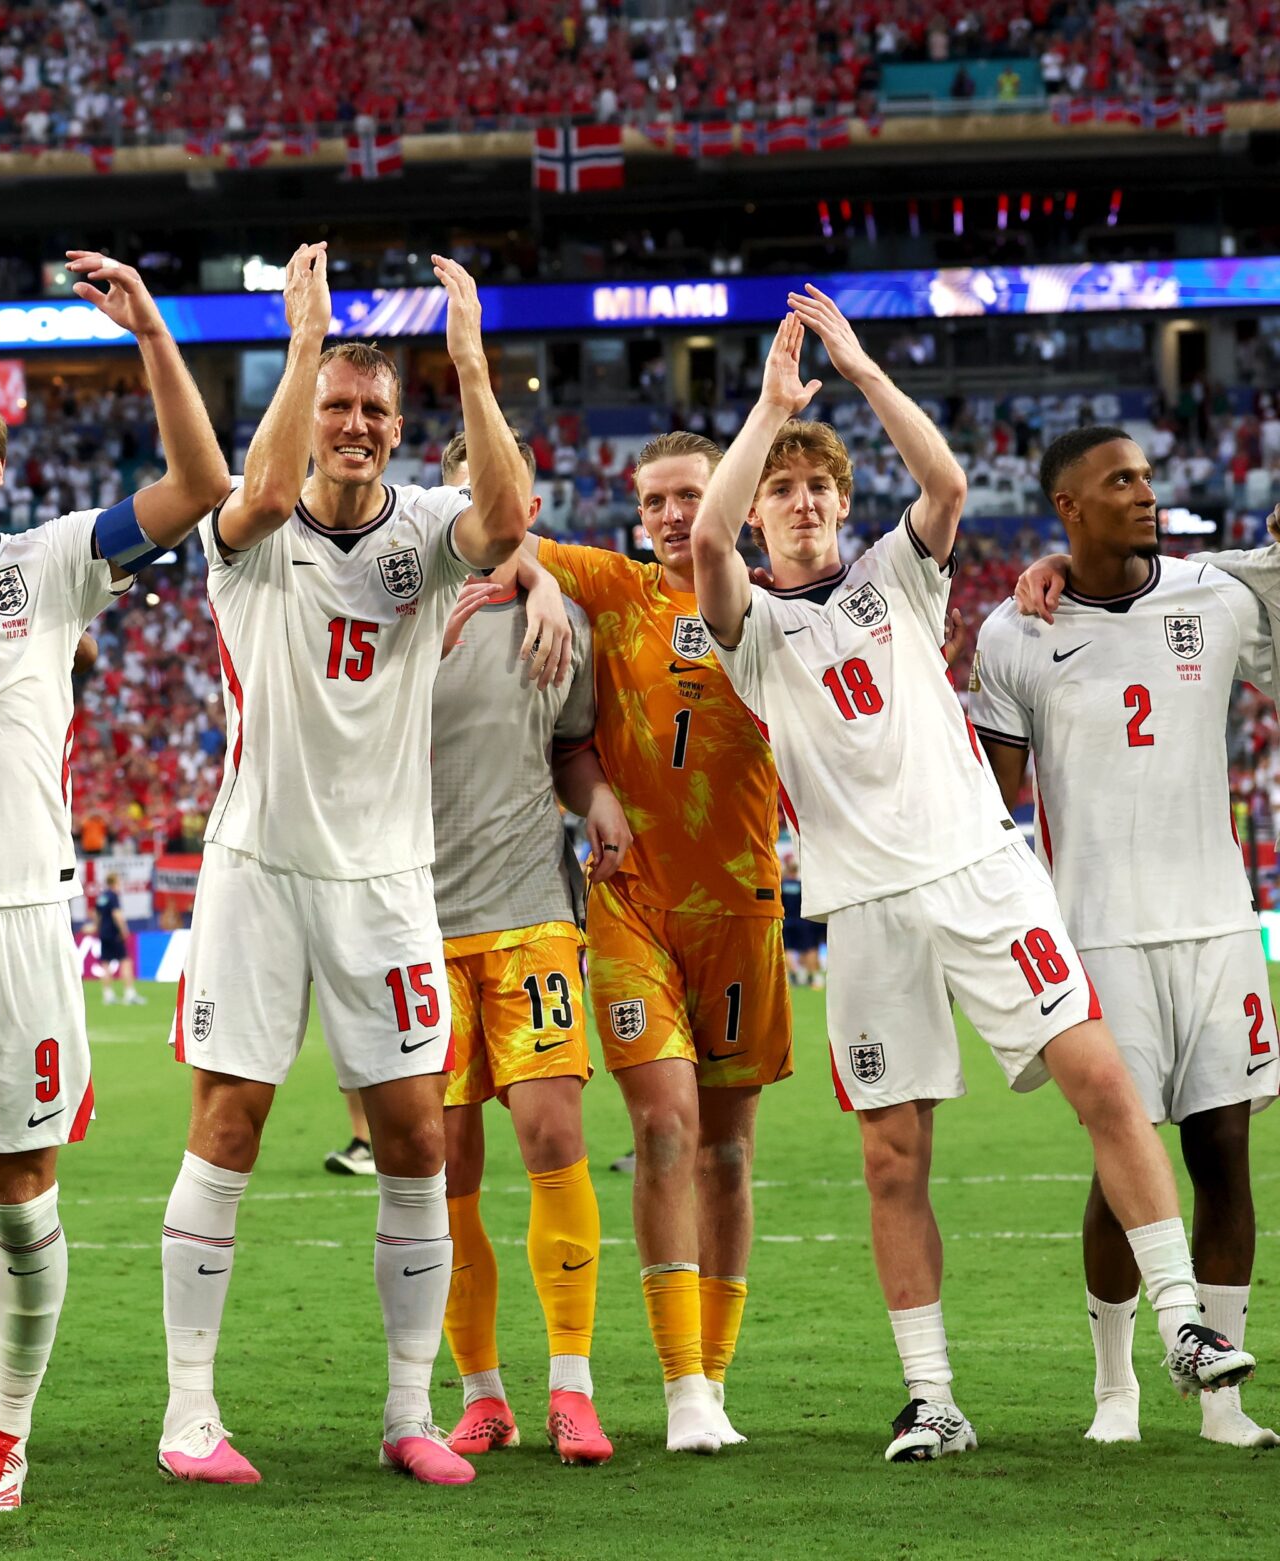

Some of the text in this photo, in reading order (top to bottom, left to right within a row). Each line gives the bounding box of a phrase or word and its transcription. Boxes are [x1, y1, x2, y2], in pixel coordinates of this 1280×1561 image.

[593, 283, 728, 320] MIAMI
[2, 618, 28, 629] NORWAY
[6, 629, 28, 639] 11.07.26
[326, 619, 378, 682] 15
[678, 680, 705, 690] NORWAY
[822, 657, 884, 721] 18
[1176, 664, 1202, 672] NORWAY
[1180, 673, 1201, 681] 11.07.26
[672, 708, 691, 769] 1
[1124, 684, 1155, 747] 2
[1010, 926, 1070, 997] 18
[385, 961, 441, 1032] 15
[522, 971, 574, 1031] 13
[724, 981, 742, 1043] 1
[1243, 992, 1271, 1056] 2
[34, 1038, 61, 1103] 9
